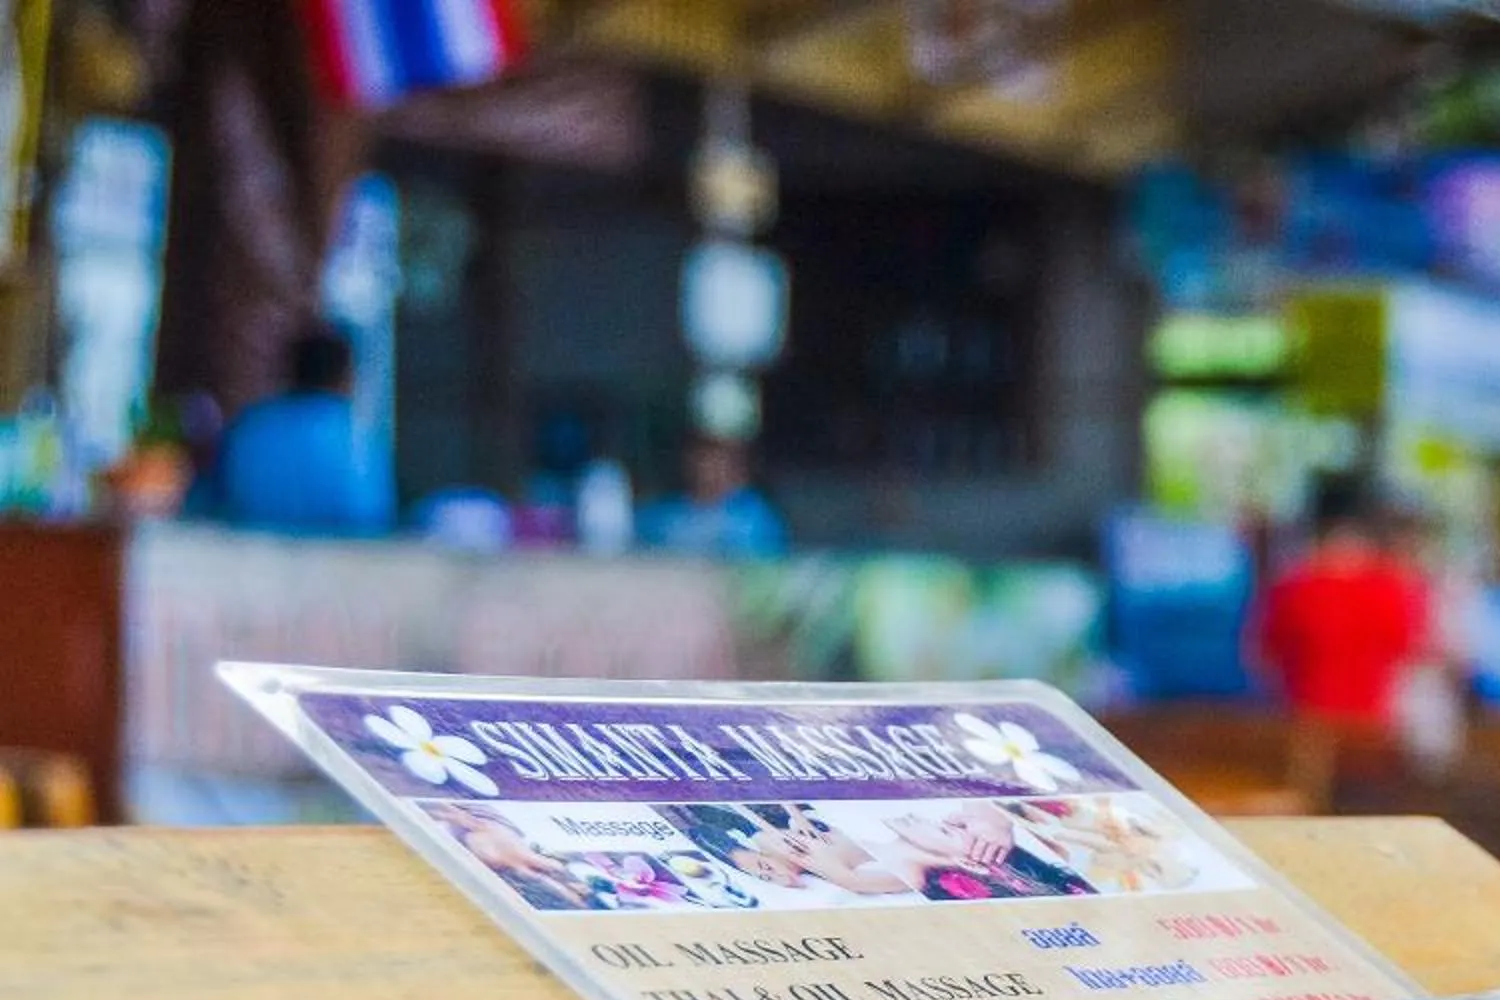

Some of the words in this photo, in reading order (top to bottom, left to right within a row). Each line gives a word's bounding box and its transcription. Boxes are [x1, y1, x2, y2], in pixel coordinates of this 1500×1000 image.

[470, 720, 752, 781] SIMANTA
[719, 723, 983, 781] MASSAGE
[549, 814, 675, 841] Massage
[591, 942, 672, 969] OIL
[674, 936, 865, 969] MASSAGE
